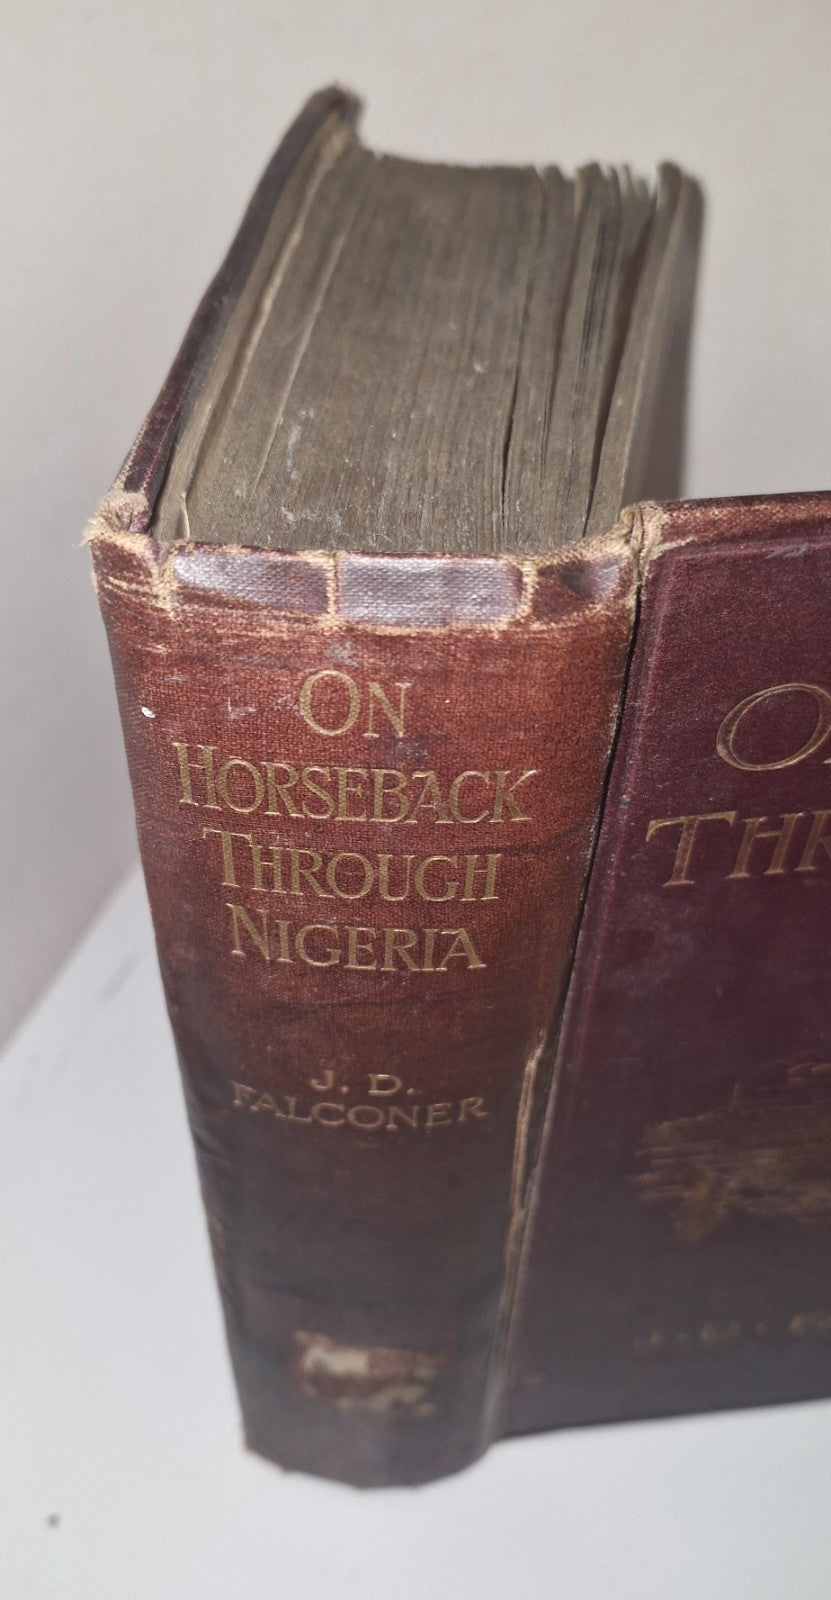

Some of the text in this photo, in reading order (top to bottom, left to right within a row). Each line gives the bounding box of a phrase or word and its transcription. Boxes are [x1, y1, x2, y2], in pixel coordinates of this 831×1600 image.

[300, 669, 412, 738] ON
[173, 742, 538, 824] HORSEBACK
[203, 827, 502, 902] THROUGH
[226, 903, 487, 972] NIGERIA
[230, 1080, 489, 1131] FALCONER
